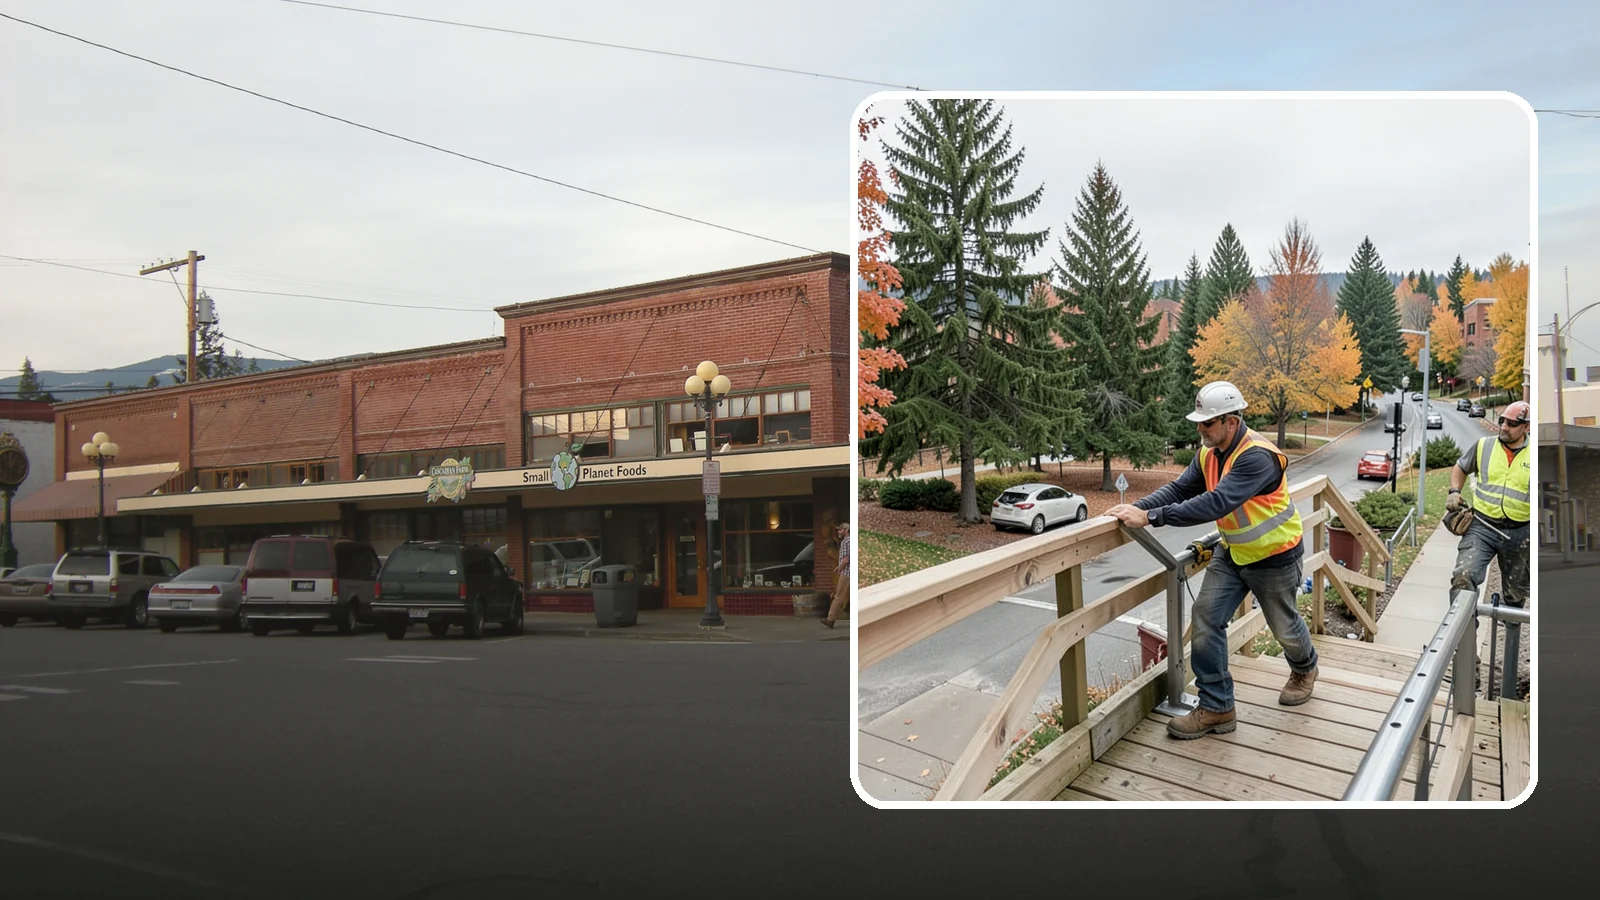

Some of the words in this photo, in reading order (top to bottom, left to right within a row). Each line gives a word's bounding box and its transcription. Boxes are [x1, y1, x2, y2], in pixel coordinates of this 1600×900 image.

[523, 472, 549, 482] Small
[583, 467, 614, 479] Planet
[617, 464, 647, 476] Foods
